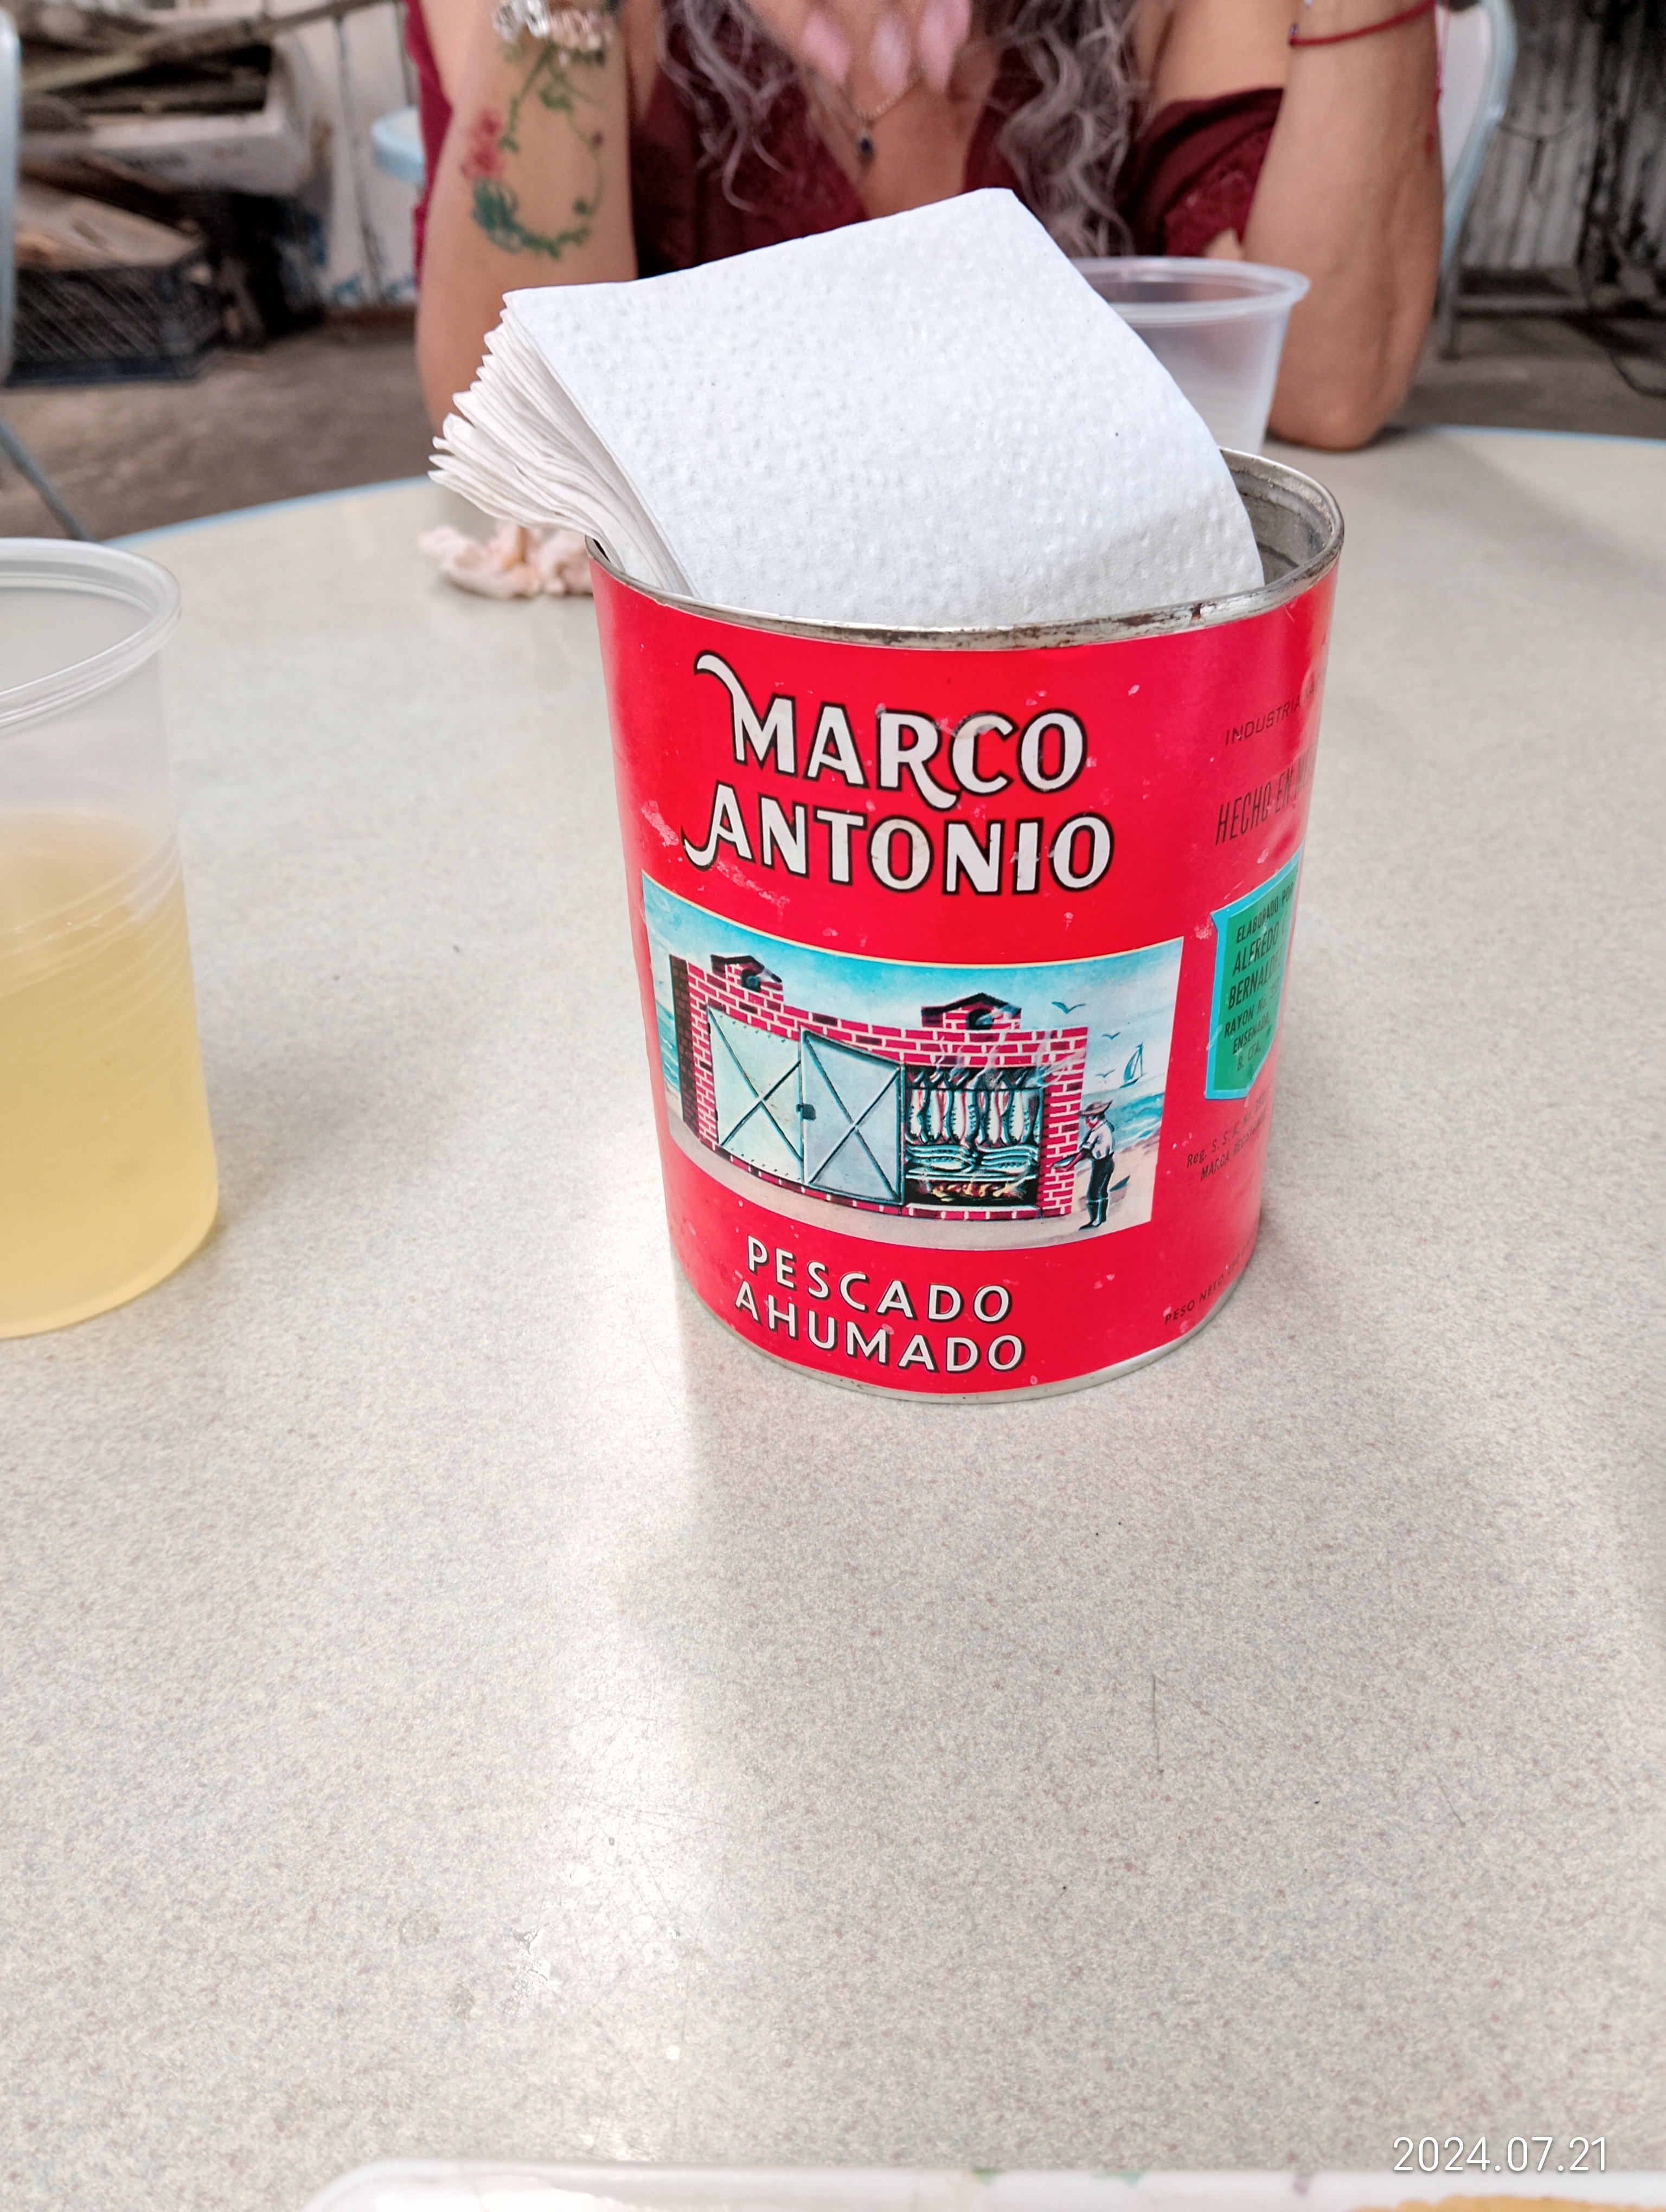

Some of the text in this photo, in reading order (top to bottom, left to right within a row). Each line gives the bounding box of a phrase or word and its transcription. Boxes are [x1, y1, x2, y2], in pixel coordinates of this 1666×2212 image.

[694, 650, 1087, 811] MARCO
[1225, 695, 1300, 746] INDUSTRIA
[682, 779, 1114, 896] ANTONIO
[1214, 780, 1272, 846] HECHO
[1236, 896, 1279, 944] ELABORADO
[1232, 922, 1279, 977] ALFREDO
[1224, 1005, 1254, 1039] RAYON
[1186, 1148, 1207, 1169] Reg.
[1200, 1150, 1229, 1181] MARCA
[746, 1234, 1012, 1323] PESCADO
[1164, 1274, 1225, 1325] PESO NETO
[734, 1279, 1027, 1373] AHUMADO
